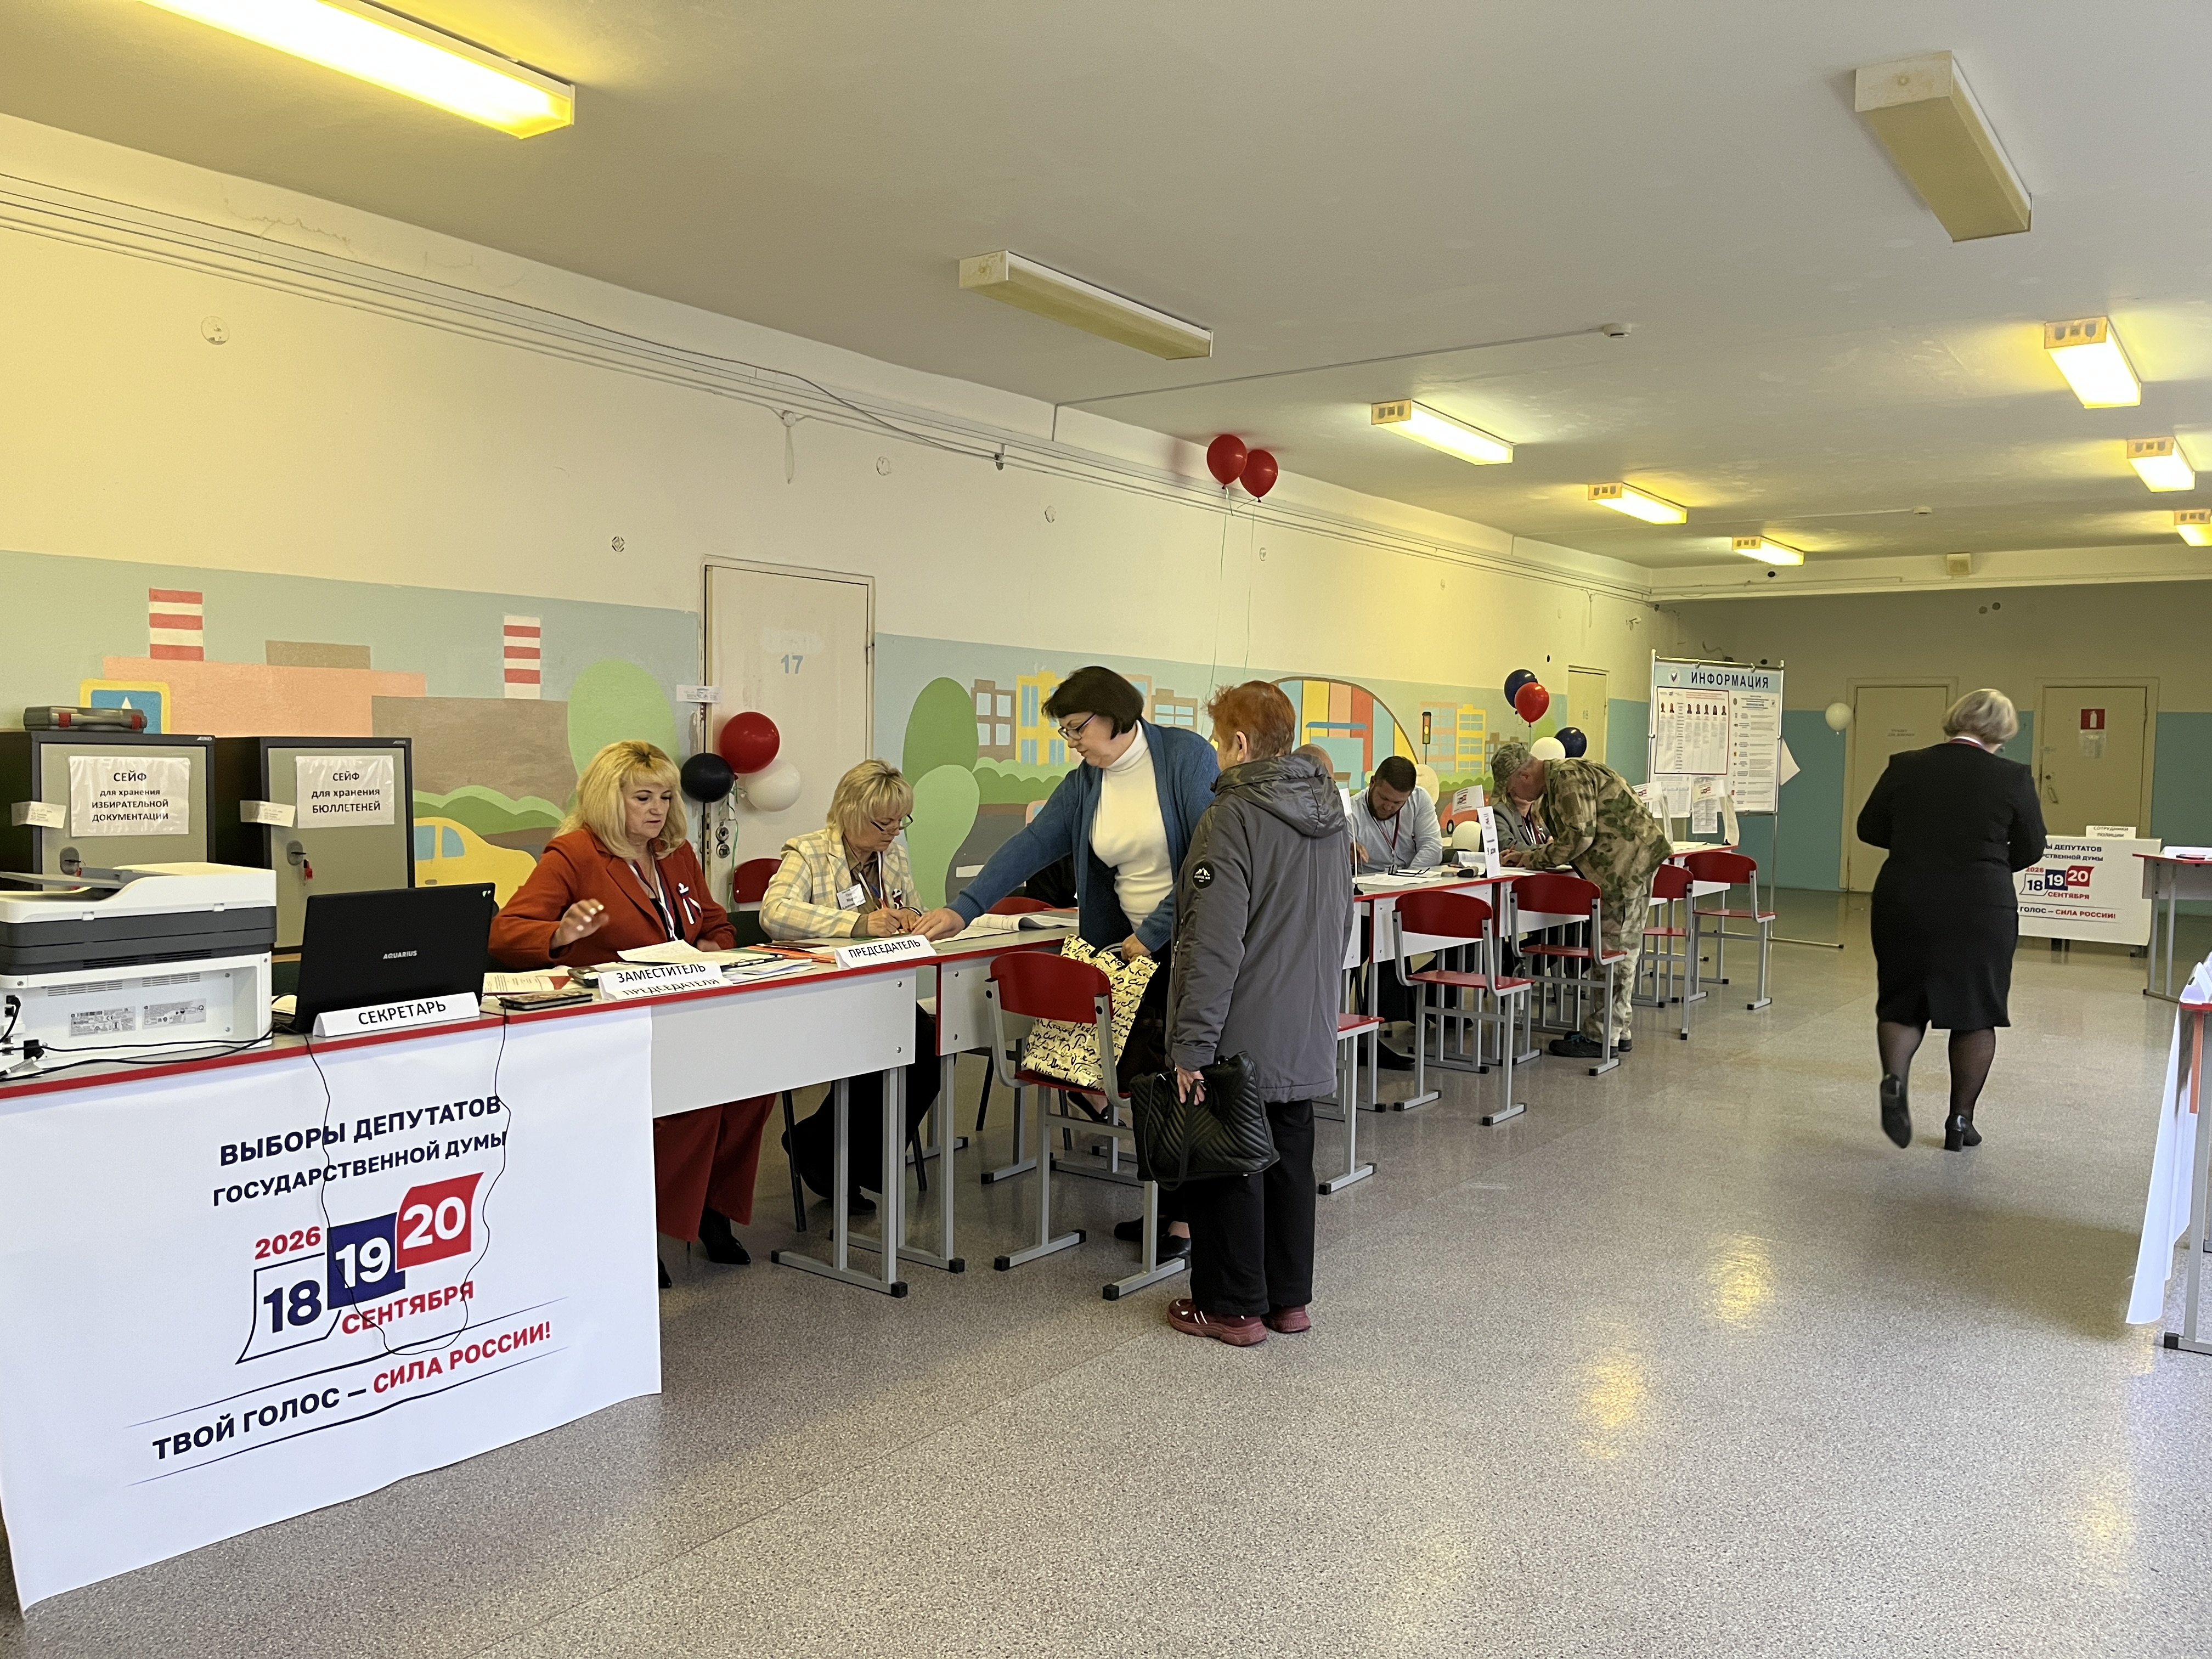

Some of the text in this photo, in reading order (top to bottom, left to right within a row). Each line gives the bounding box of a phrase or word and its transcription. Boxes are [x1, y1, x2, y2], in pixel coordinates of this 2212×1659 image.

[781, 654, 803, 674] 17
[1691, 672, 1768, 690] ИНФОРМАЦИЯ
[114, 770, 146, 782] СЕЙФ
[332, 770, 359, 781] СЕЙФ
[333, 789, 380, 798] хранения
[92, 799, 168, 809] ИЗБИРАТЕЛЬНОЙ
[312, 801, 380, 813] БЮЛЛЕТЕНЕЙ
[92, 813, 168, 822] ДОКУМЕНТАЦИИ
[2047, 874, 2064, 886] 19
[2068, 870, 2089, 882] 20
[2027, 879, 2043, 891] 18
[2047, 891, 2090, 900] СЕНТЯБРЯ
[2080, 911, 2115, 919] РОССИИ!
[383, 950, 417, 959] AQUARIUS
[849, 940, 921, 958] ПРЕДСЕДАТЕЛЬ
[616, 964, 706, 983] ЗАМЕСТИТЕЛЬ
[622, 979, 720, 995] ПРЕДСЕДАТЕЛЯ
[358, 1001, 446, 1025] СЕКРЕТАРЬ
[221, 1096, 500, 1166] ВЫБОРЫ ДЕПУТАТОВ
[213, 1131, 507, 1206] ГОСУДАРСТВЕННОЙ ДУМЫ
[403, 1197, 466, 1250] 20
[255, 1226, 321, 1260] 2026
[335, 1237, 391, 1289] 19
[263, 1279, 322, 1334] 18
[342, 1280, 474, 1334] СЕНТЯБРЯ
[152, 1413, 234, 1460] ТВОЙ
[244, 1388, 340, 1433] ГОЛОС
[373, 1357, 443, 1393] СИЛА
[450, 1321, 551, 1370] РОССИИ!
